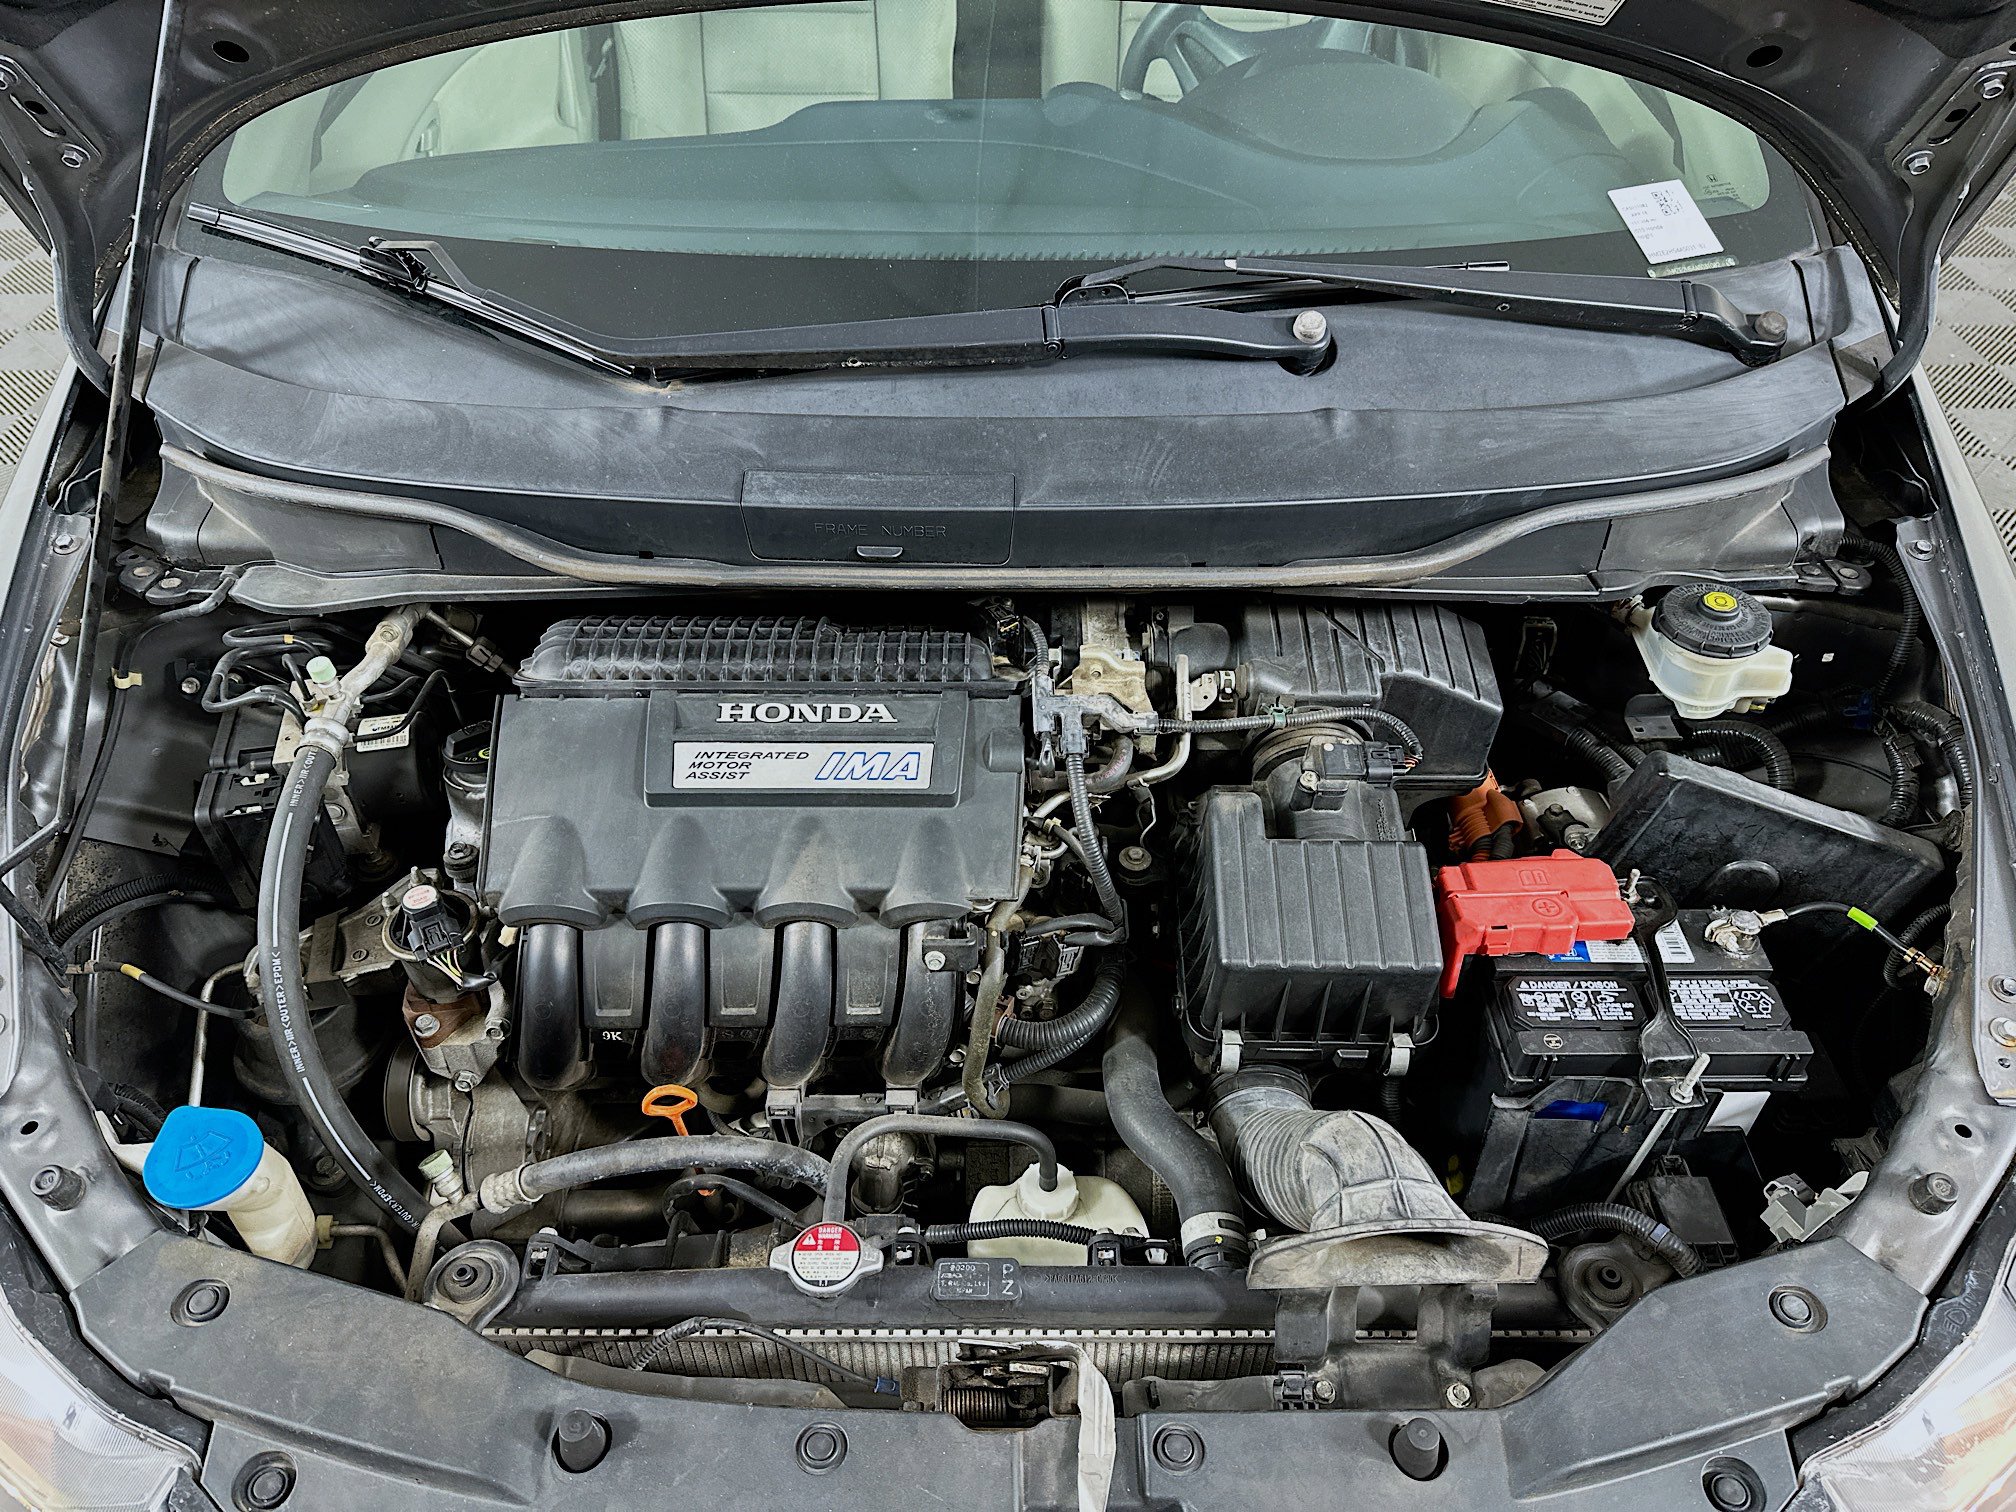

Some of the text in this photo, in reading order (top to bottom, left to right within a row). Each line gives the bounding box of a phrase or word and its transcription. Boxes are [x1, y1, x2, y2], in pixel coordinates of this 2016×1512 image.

[814, 522, 947, 537] FRAME NUMBER
[716, 702, 898, 723] HONDA
[695, 751, 810, 760] INTEGRATED
[688, 761, 752, 770] MOTOR
[815, 751, 921, 781] IMA
[685, 771, 750, 780] ASSIST
[1529, 980, 1571, 989] DANGER
[1580, 980, 1618, 989] POISON
[602, 1031, 623, 1041] 9K
[1002, 1263, 1014, 1279] P
[1001, 1279, 1014, 1295] Z
